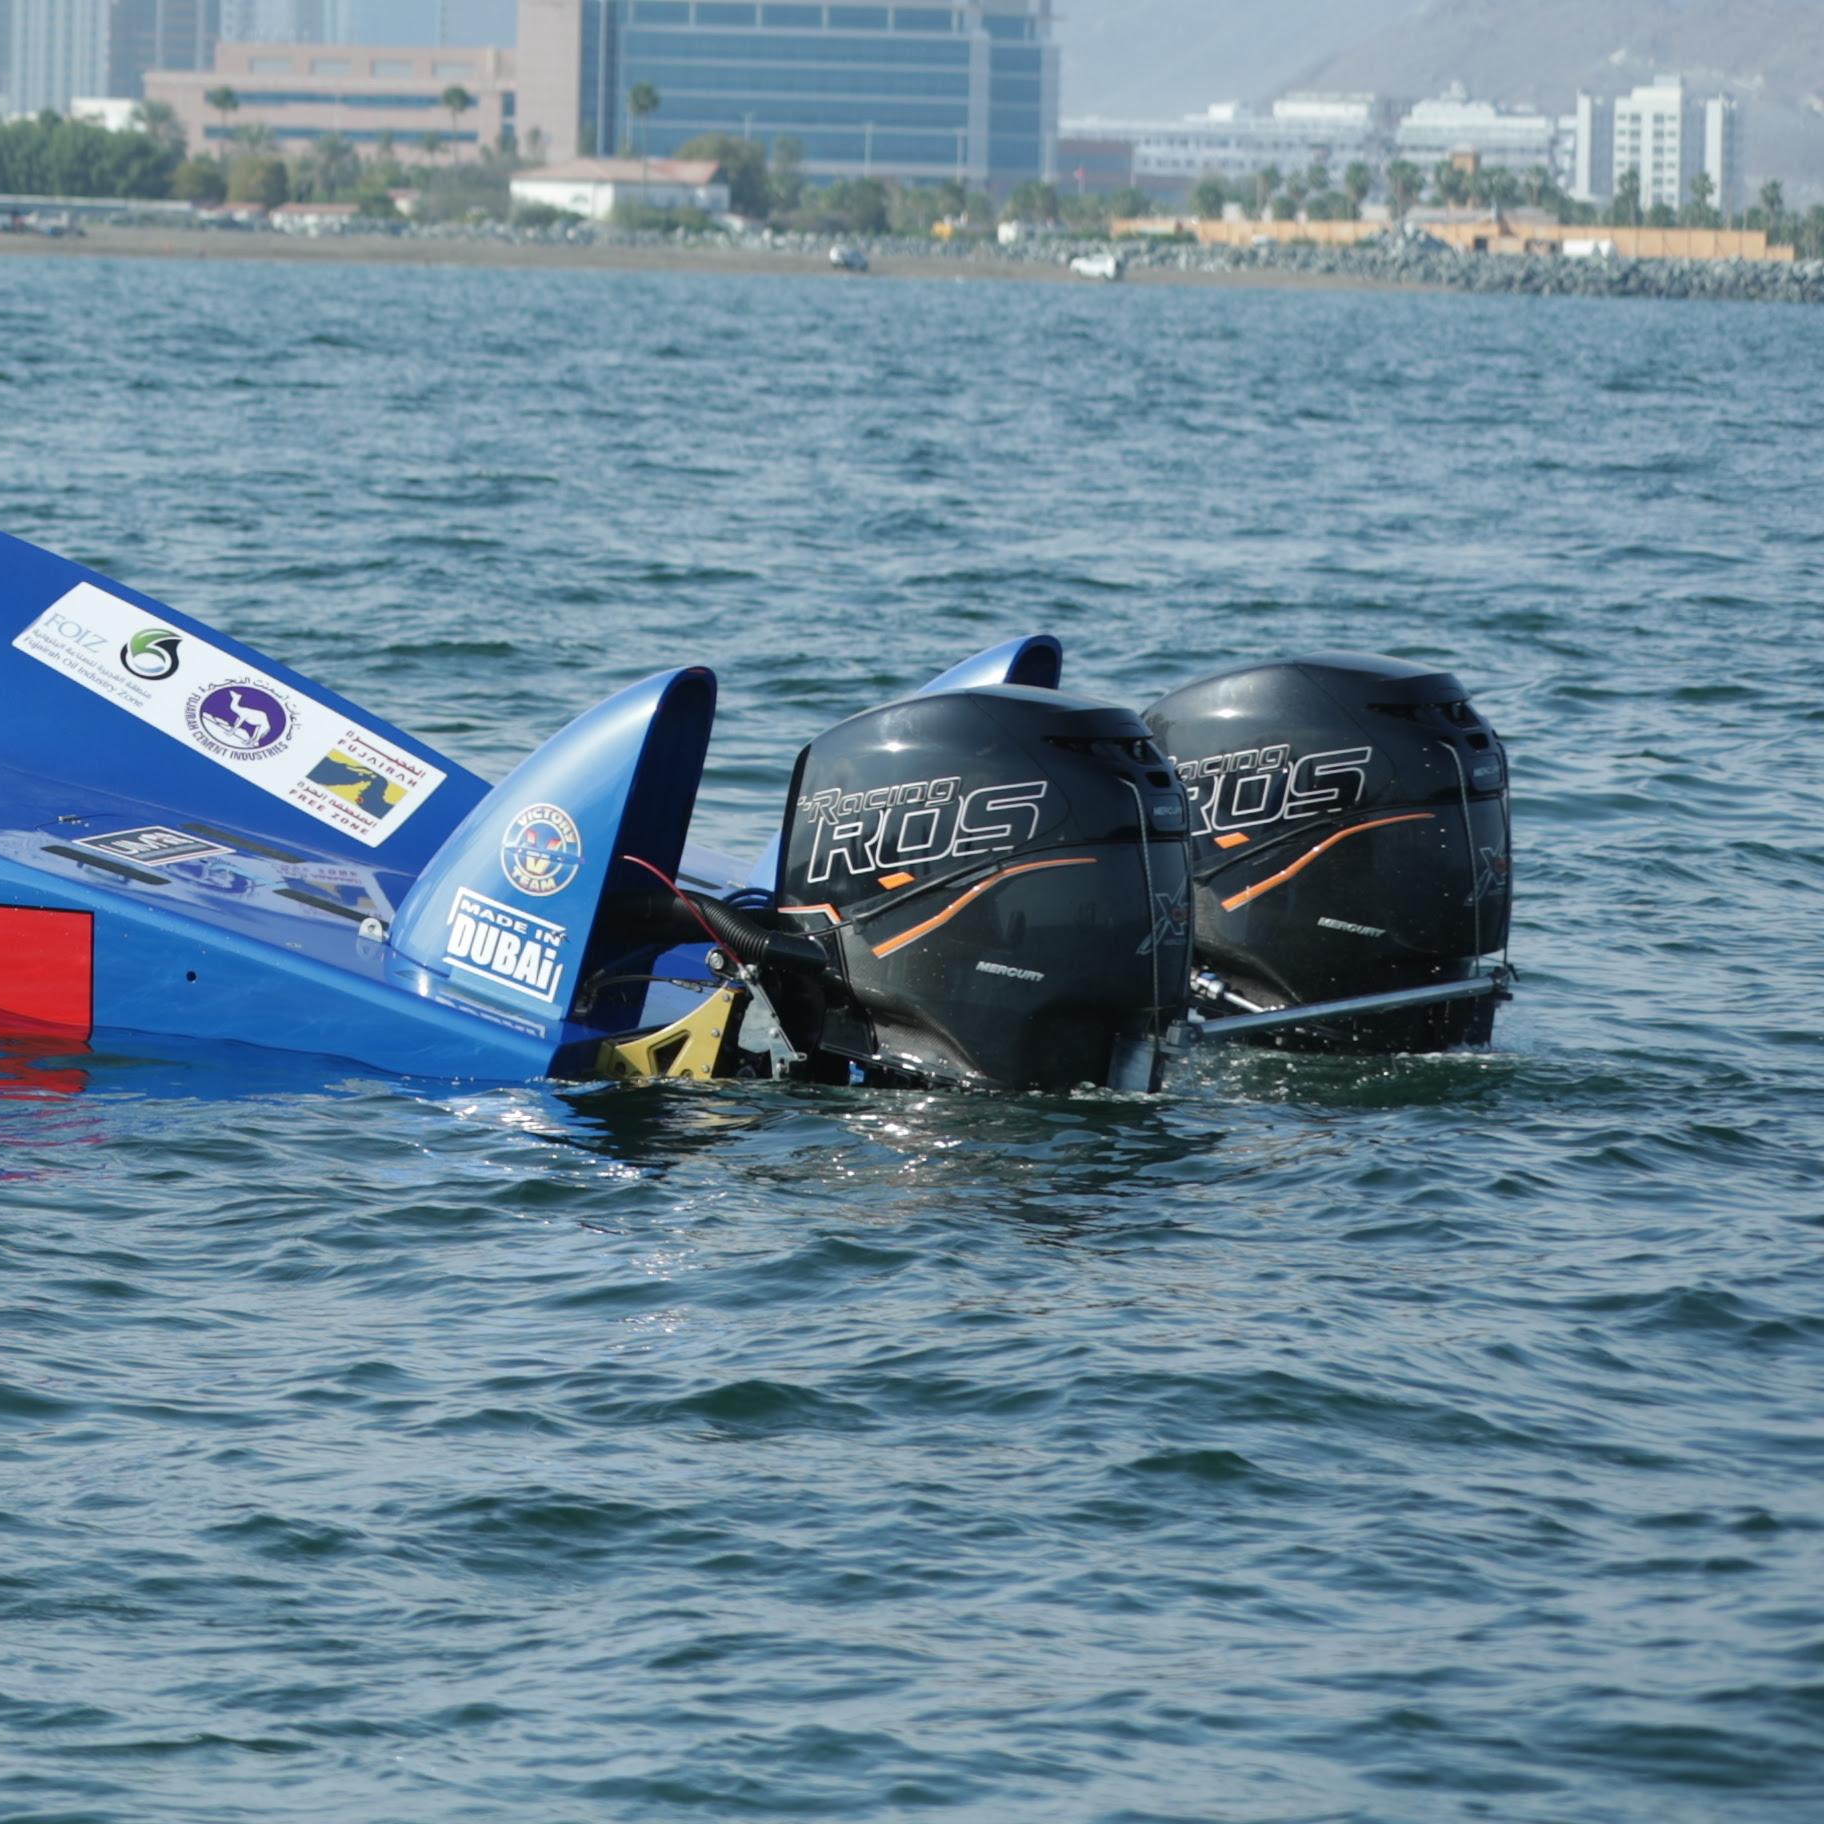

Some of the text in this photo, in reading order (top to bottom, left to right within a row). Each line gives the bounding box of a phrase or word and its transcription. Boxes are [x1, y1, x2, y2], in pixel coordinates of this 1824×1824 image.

[42, 612, 109, 654] FOIZ
[23, 635, 144, 708] Fujairah Oil Industry Zone
[192, 730, 229, 757] CEMENT
[229, 740, 289, 761] INDUSTRIES
[337, 738, 419, 788] FUJAIRAH
[288, 788, 370, 836] FREE ZONE
[806, 776, 962, 826] Racing
[517, 807, 576, 844] VICTORY
[511, 866, 558, 892] TEAM
[459, 899, 562, 948] MADE IN
[1317, 916, 1387, 939] MERCURY
[975, 960, 1045, 982] MERCURY
